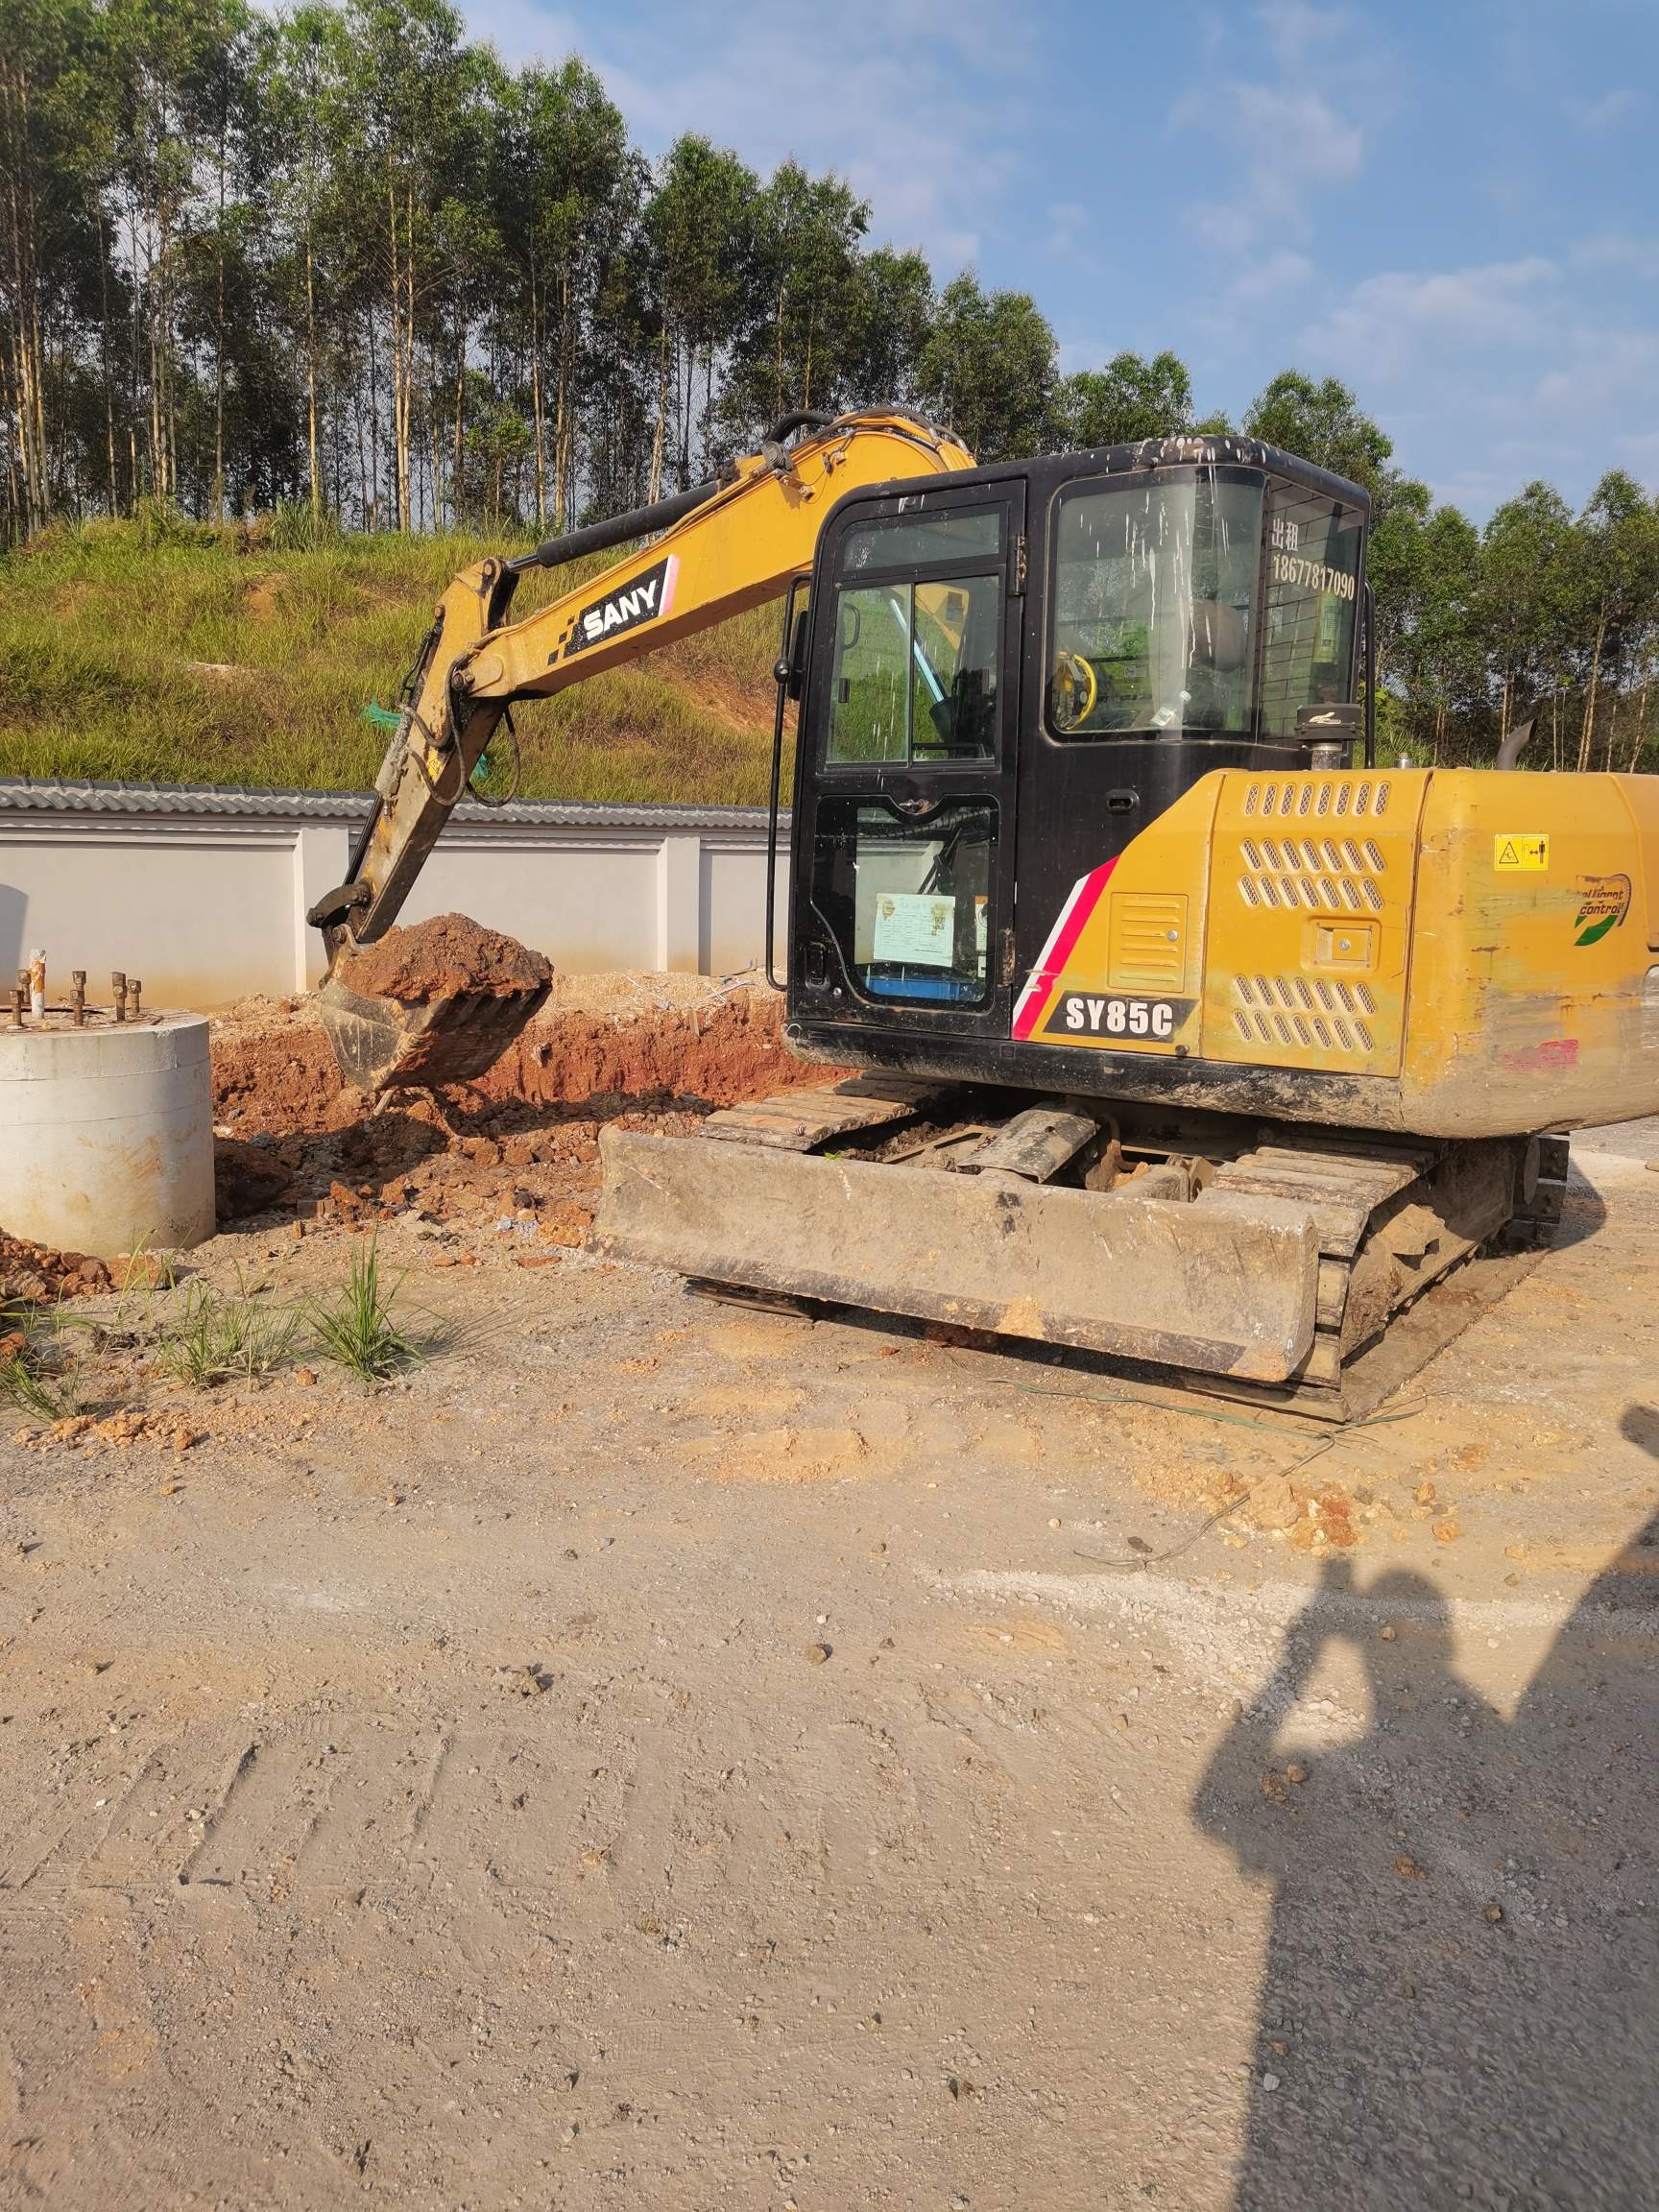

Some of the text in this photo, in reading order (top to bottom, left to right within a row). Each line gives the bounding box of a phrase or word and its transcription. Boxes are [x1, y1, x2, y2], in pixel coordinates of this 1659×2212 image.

[1271, 517, 1299, 552] 出租
[1273, 554, 1355, 601] 18677817090
[583, 579, 657, 640] SANY
[1066, 998, 1173, 1036] SY85C
